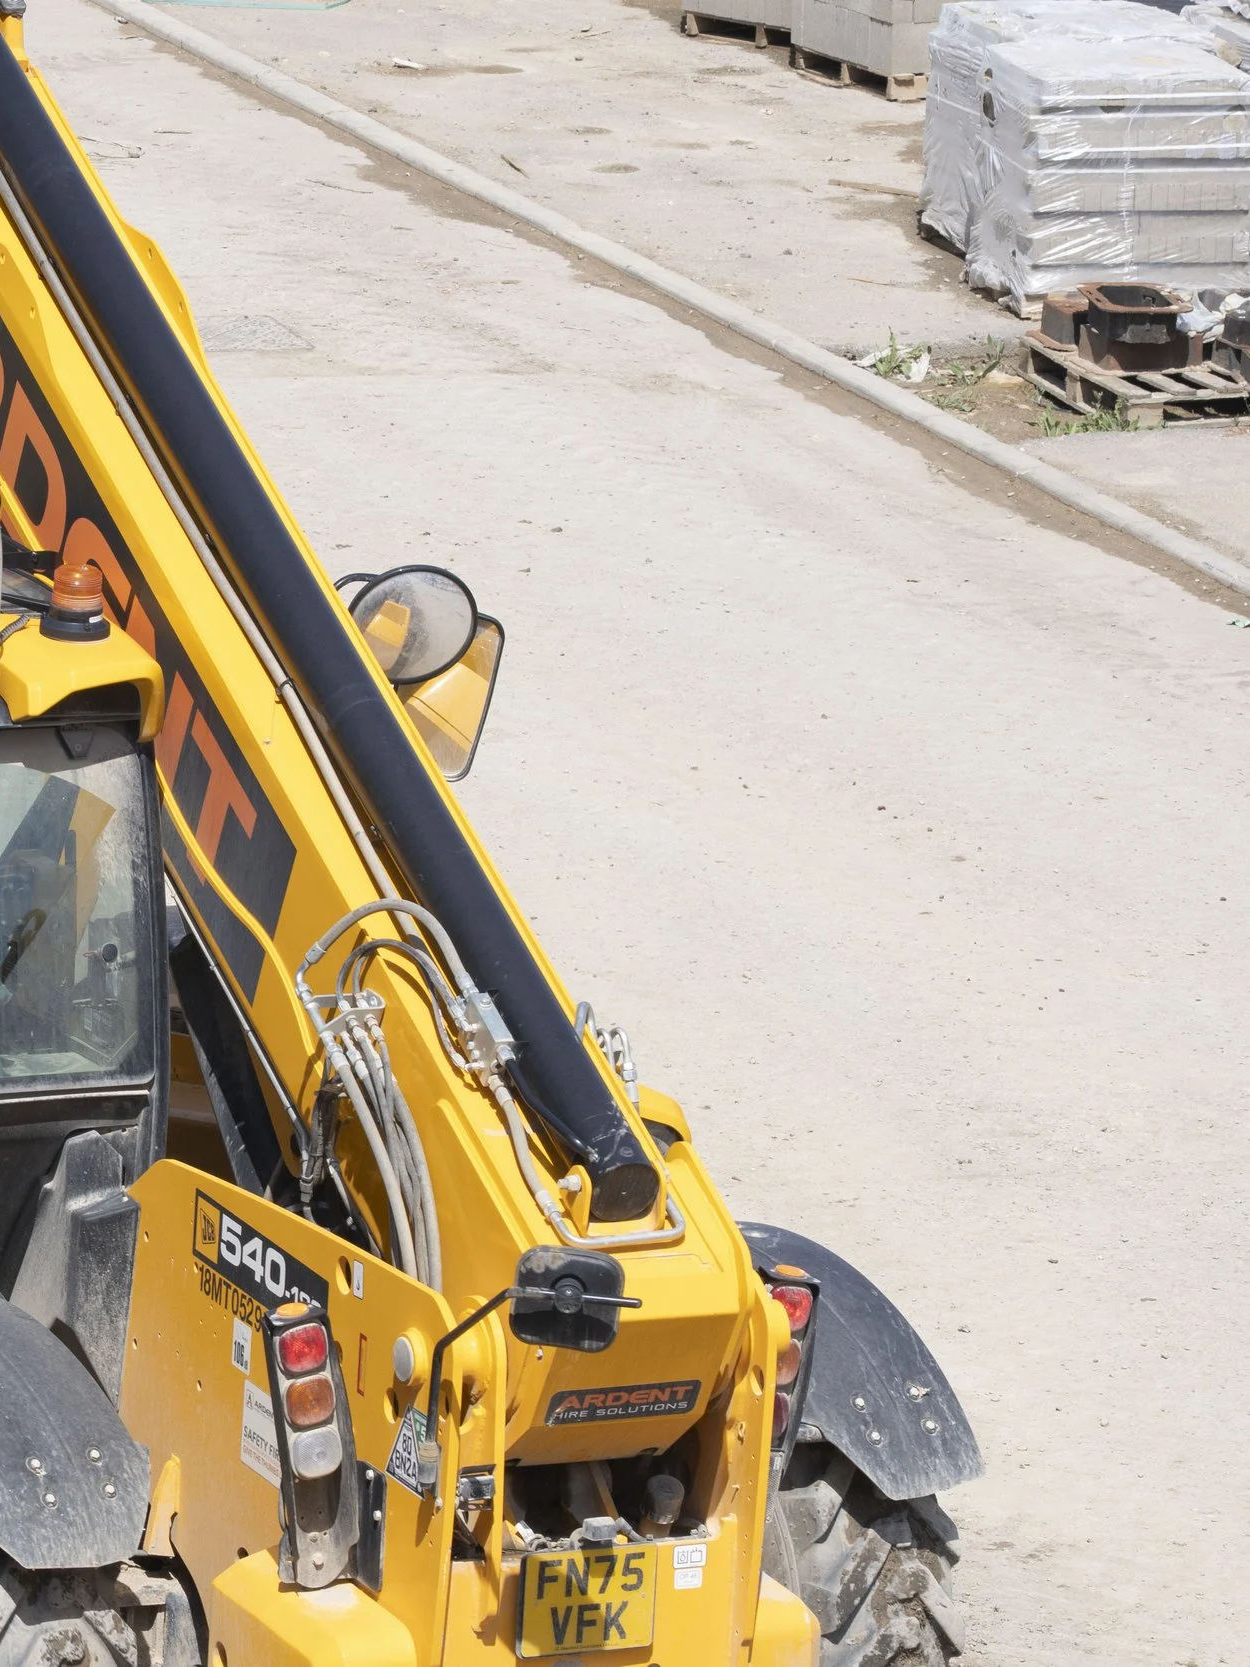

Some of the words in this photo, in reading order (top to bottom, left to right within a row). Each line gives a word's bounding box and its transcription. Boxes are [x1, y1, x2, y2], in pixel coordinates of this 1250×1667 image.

[554, 1386, 694, 1412] ARDENT
[595, 1401, 689, 1417] SOLUTIONS
[243, 1425, 268, 1452] SAFETY
[535, 1552, 646, 1600] FN75
[550, 1601, 629, 1646] VFK
